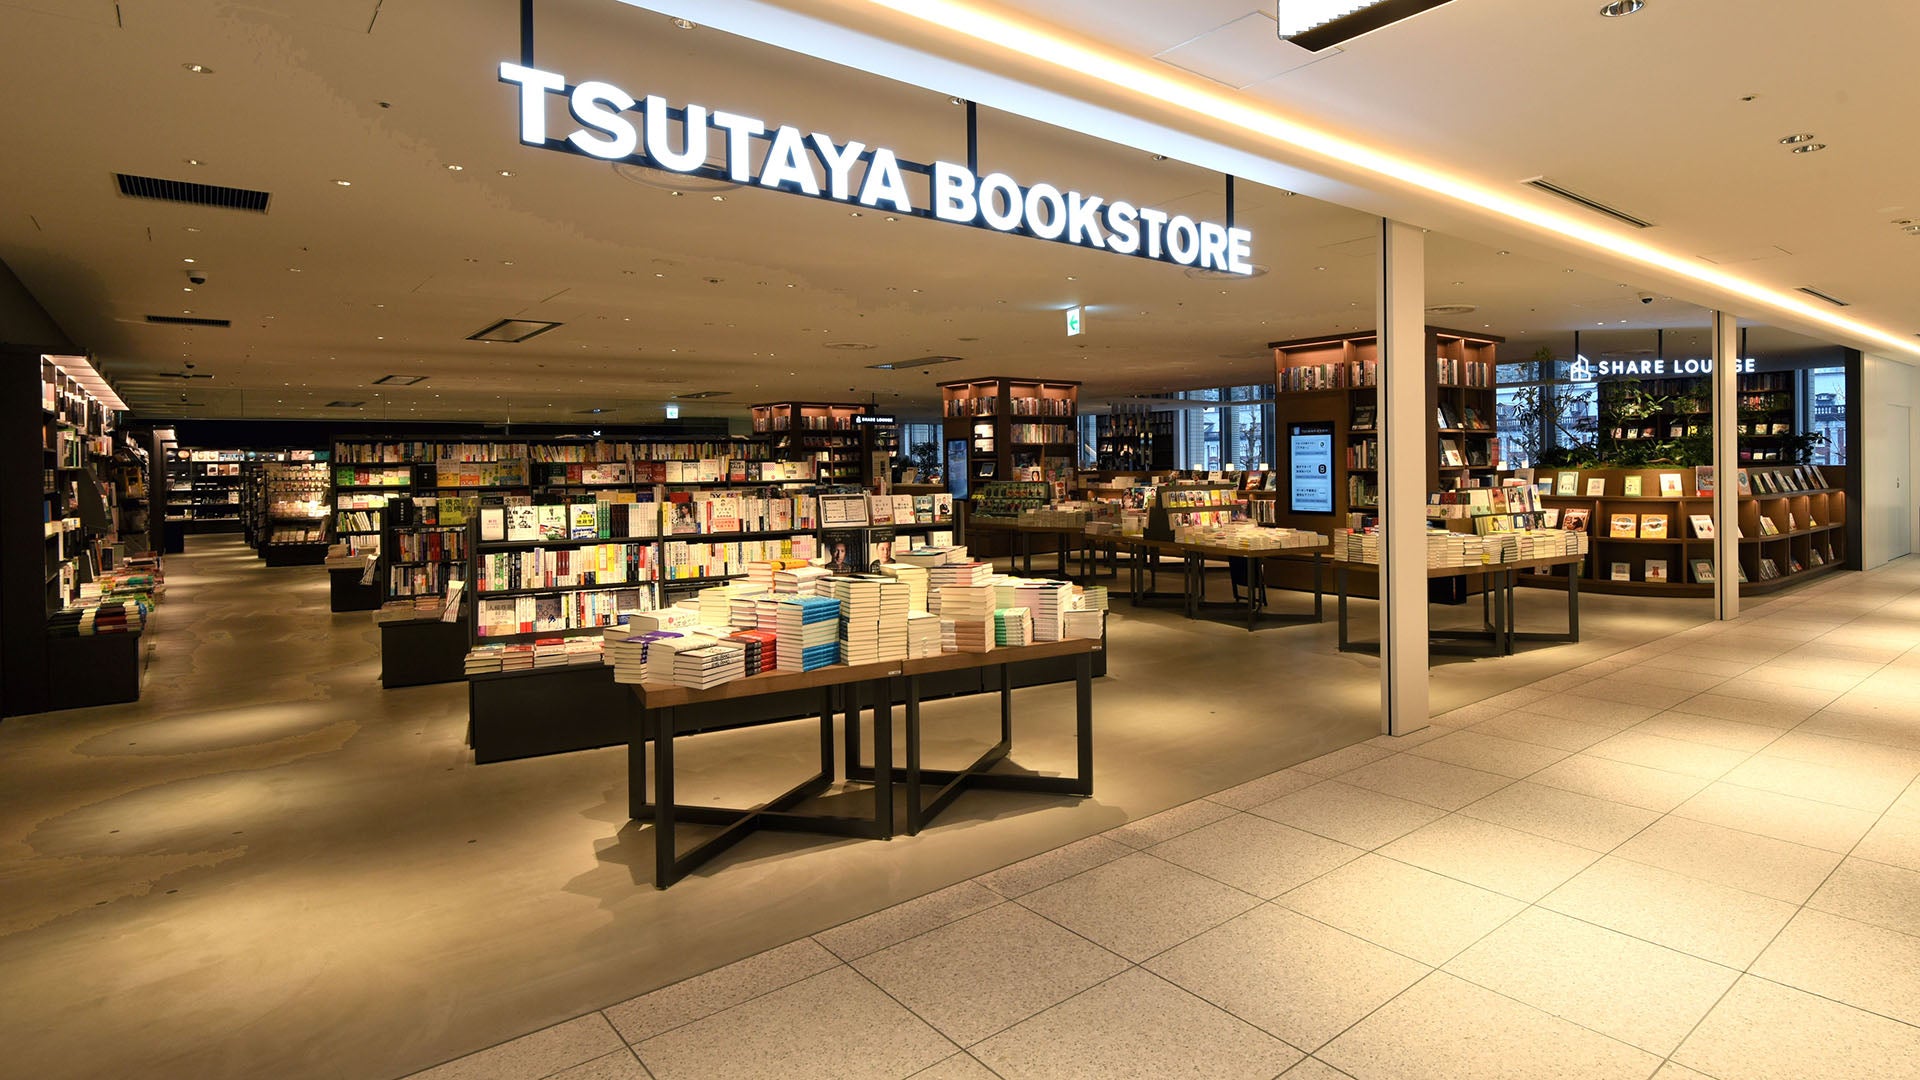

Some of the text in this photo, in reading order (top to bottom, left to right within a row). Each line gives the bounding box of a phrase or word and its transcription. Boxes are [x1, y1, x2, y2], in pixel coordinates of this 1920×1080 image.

[500, 61, 1253, 276] TSUTAYA BOOKSTORE
[1598, 358, 1756, 375] SHARE LOUGE
